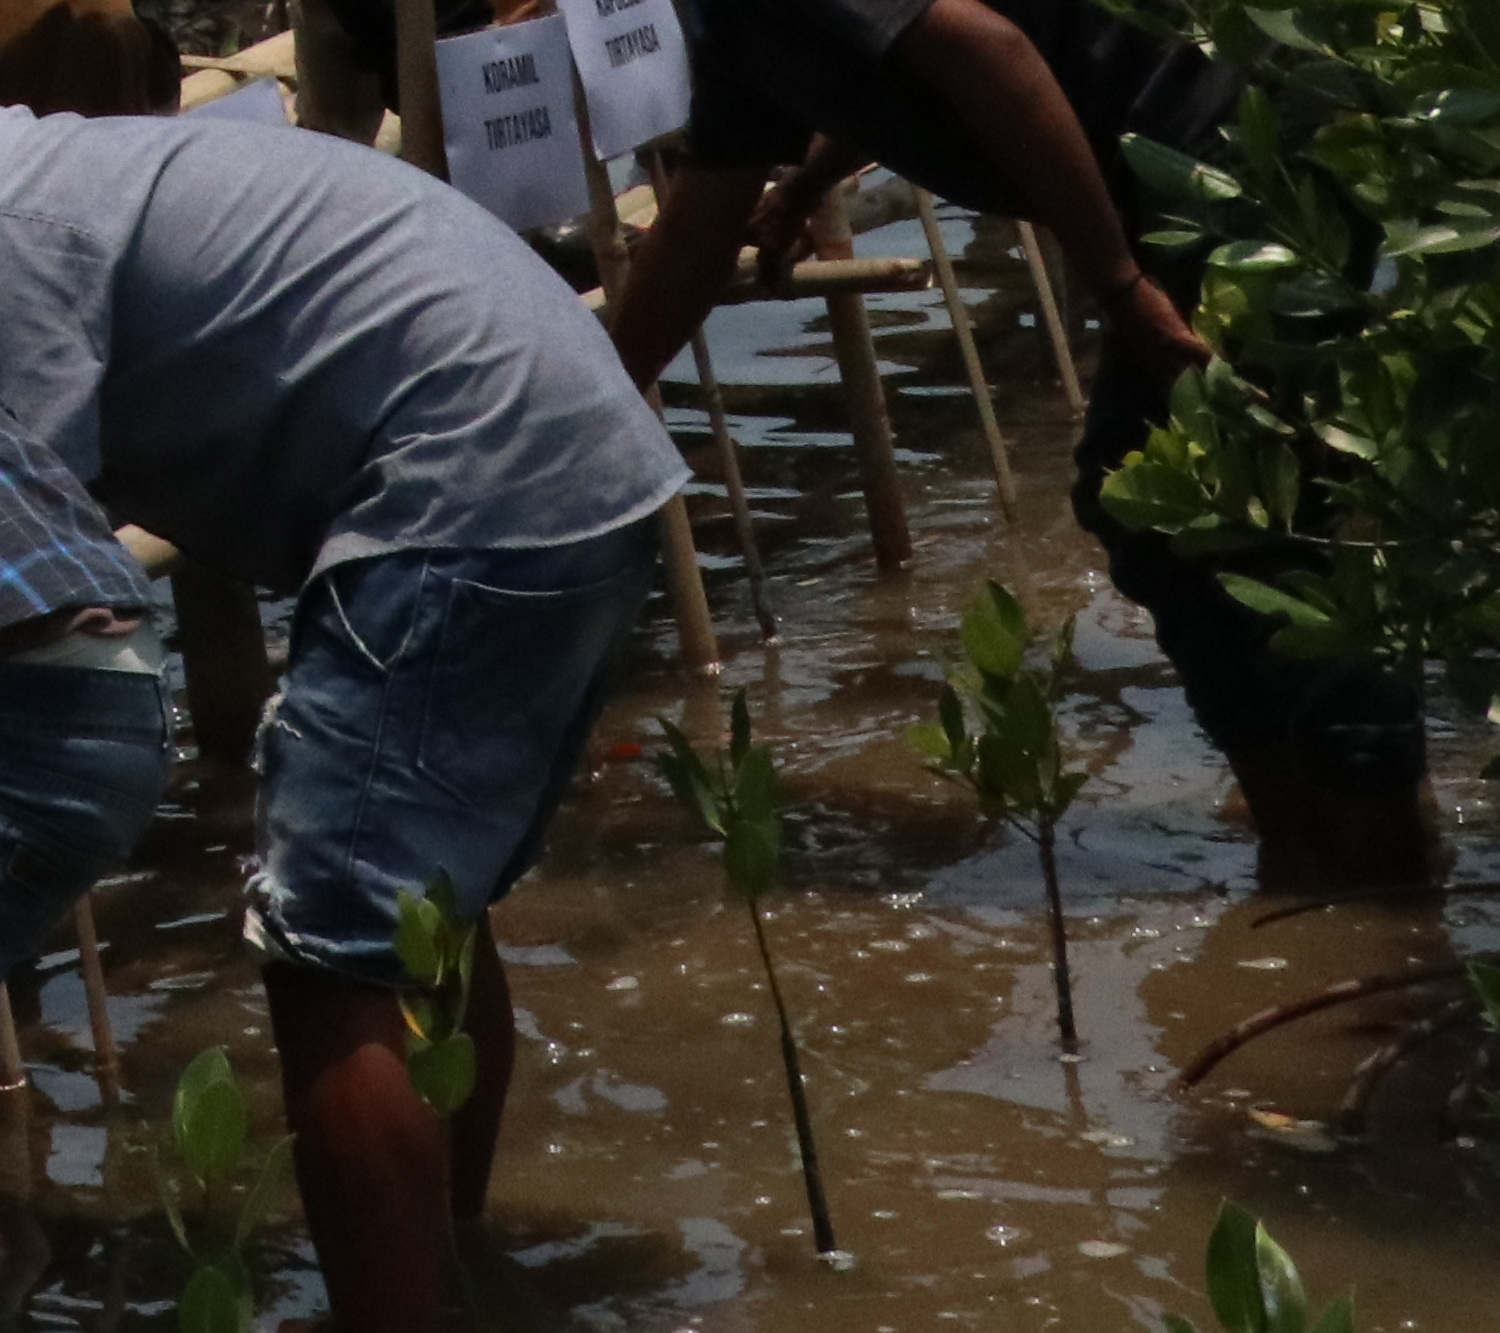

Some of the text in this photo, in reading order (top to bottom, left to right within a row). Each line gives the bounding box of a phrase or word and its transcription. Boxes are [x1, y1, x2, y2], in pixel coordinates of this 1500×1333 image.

[605, 24, 661, 67] TIRTAYASA
[482, 54, 539, 94] KORAMIL
[484, 106, 552, 149] TIRTAYASA
